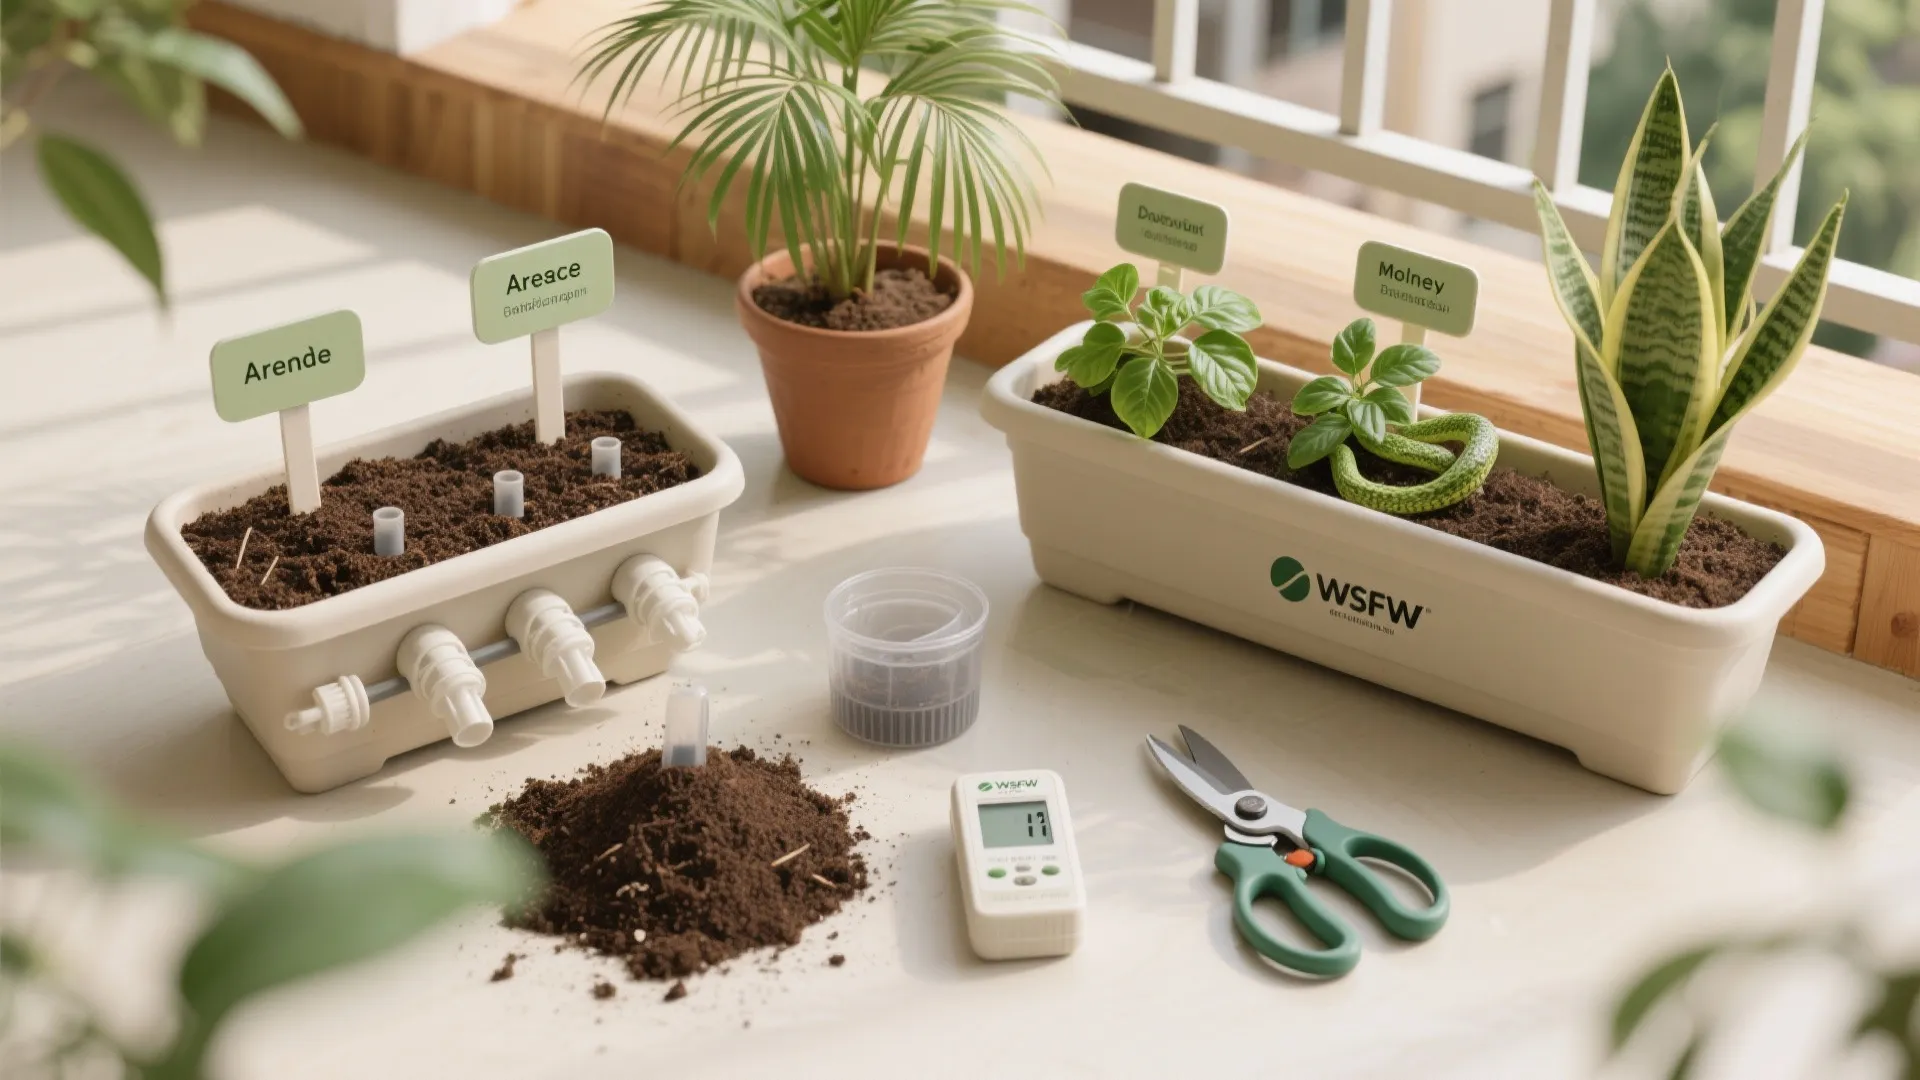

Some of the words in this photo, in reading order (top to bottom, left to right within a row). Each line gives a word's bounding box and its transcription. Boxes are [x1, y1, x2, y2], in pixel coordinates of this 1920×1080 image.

[1379, 261, 1445, 296] Molney
[244, 346, 331, 385] Arende
[1316, 573, 1424, 630] WSFW
[995, 779, 1038, 789] WSFW
